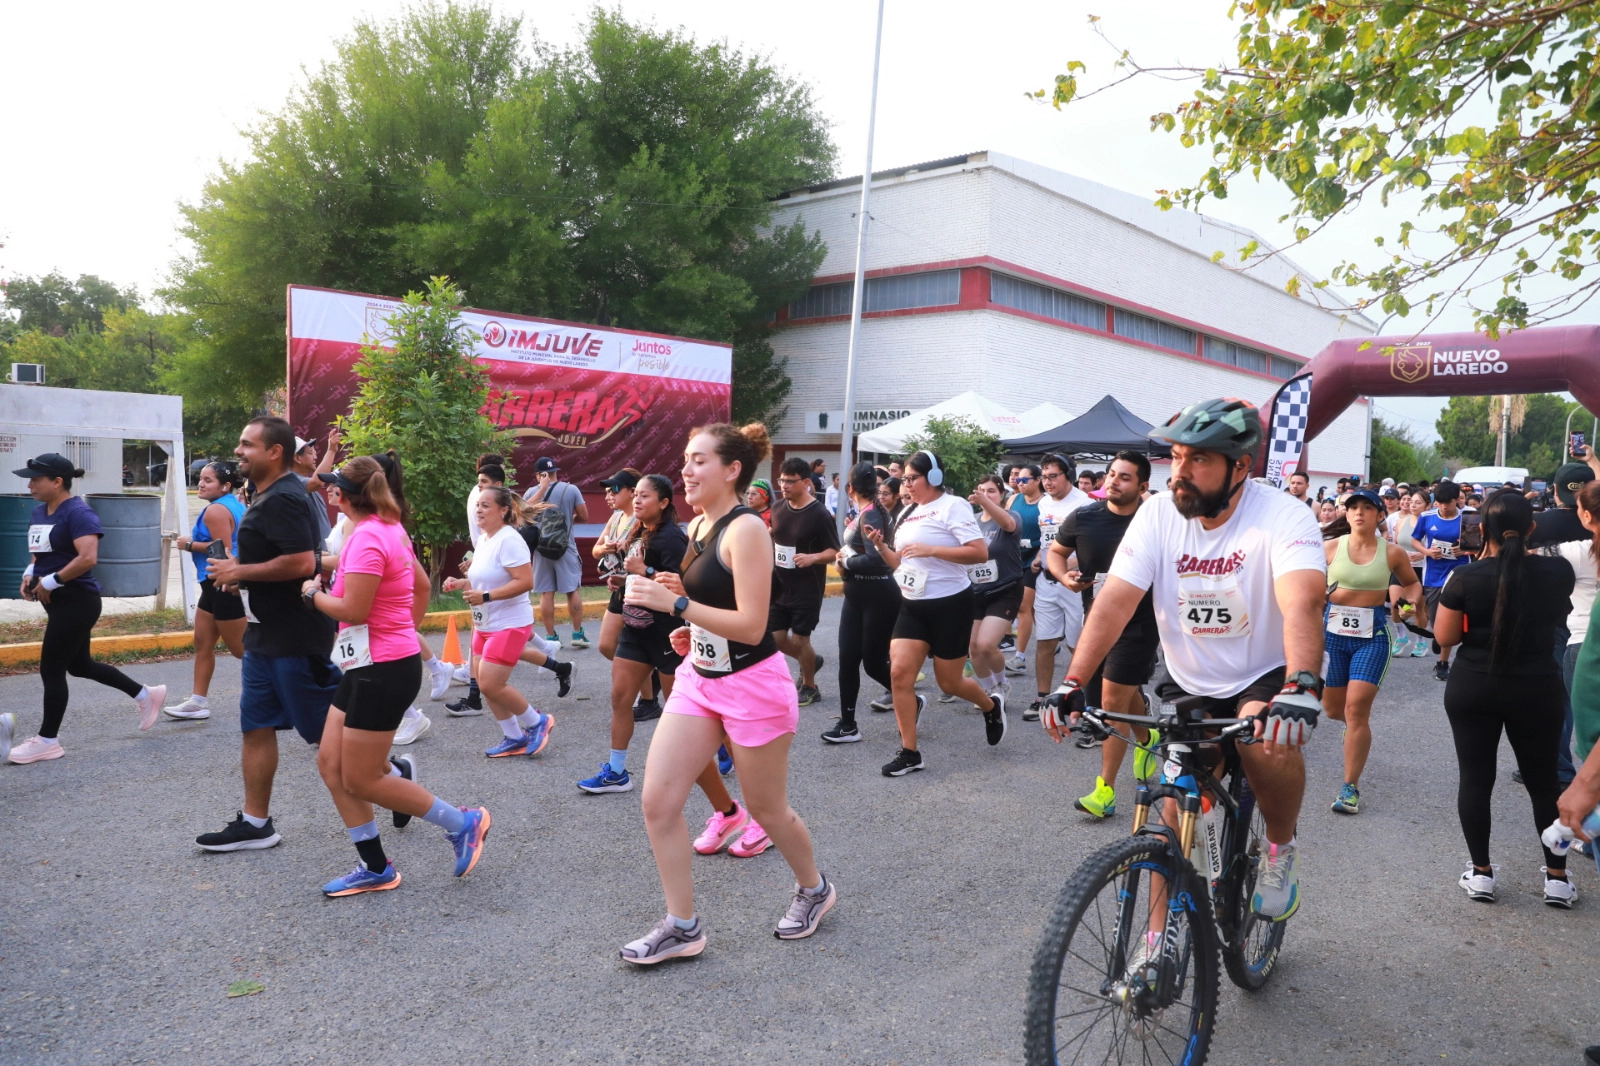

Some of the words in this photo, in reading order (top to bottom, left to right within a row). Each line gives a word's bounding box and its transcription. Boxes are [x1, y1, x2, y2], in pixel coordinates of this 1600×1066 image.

[632, 339, 671, 355] Juntos
[1433, 349, 1500, 363] NUEVO
[1433, 361, 1508, 376] LAREDO
[479, 389, 616, 435] ARRERA
[854, 410, 911, 420] IMNASIO
[558, 433, 587, 446] JOVEN
[31, 535, 40, 544] 14
[975, 569, 992, 578] 825
[903, 575, 915, 587] 12
[1187, 608, 1232, 624] 475
[1342, 617, 1359, 628] 83
[340, 643, 354, 658] 16
[1207, 822, 1220, 872] GATORADE
